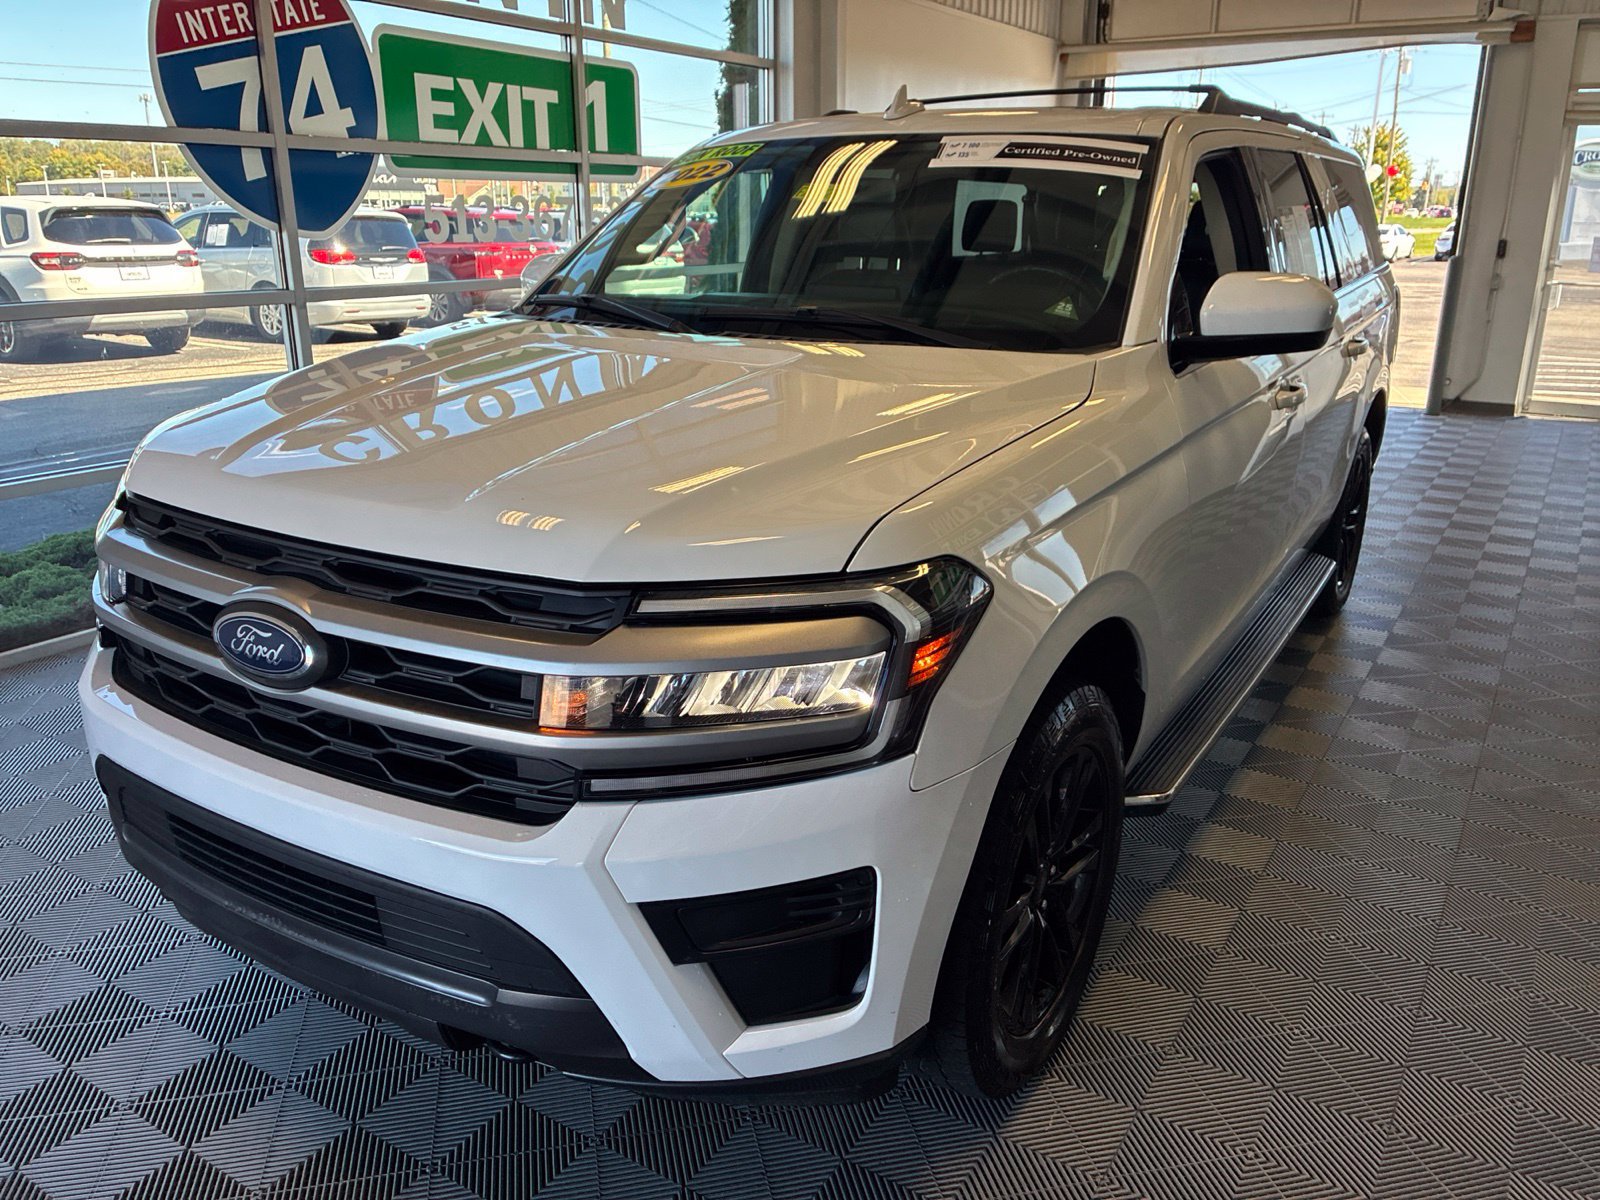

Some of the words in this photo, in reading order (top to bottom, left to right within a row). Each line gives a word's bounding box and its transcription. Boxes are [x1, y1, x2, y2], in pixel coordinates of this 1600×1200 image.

[175, 0, 326, 44] INTERTATE
[194, 44, 357, 181] 74
[413, 72, 559, 150] EXIT
[584, 80, 609, 152] 1
[664, 162, 729, 183] 022
[1004, 145, 1061, 156] Certified
[1062, 149, 1137, 165] Pre-Owned
[230, 624, 285, 664] Ford
